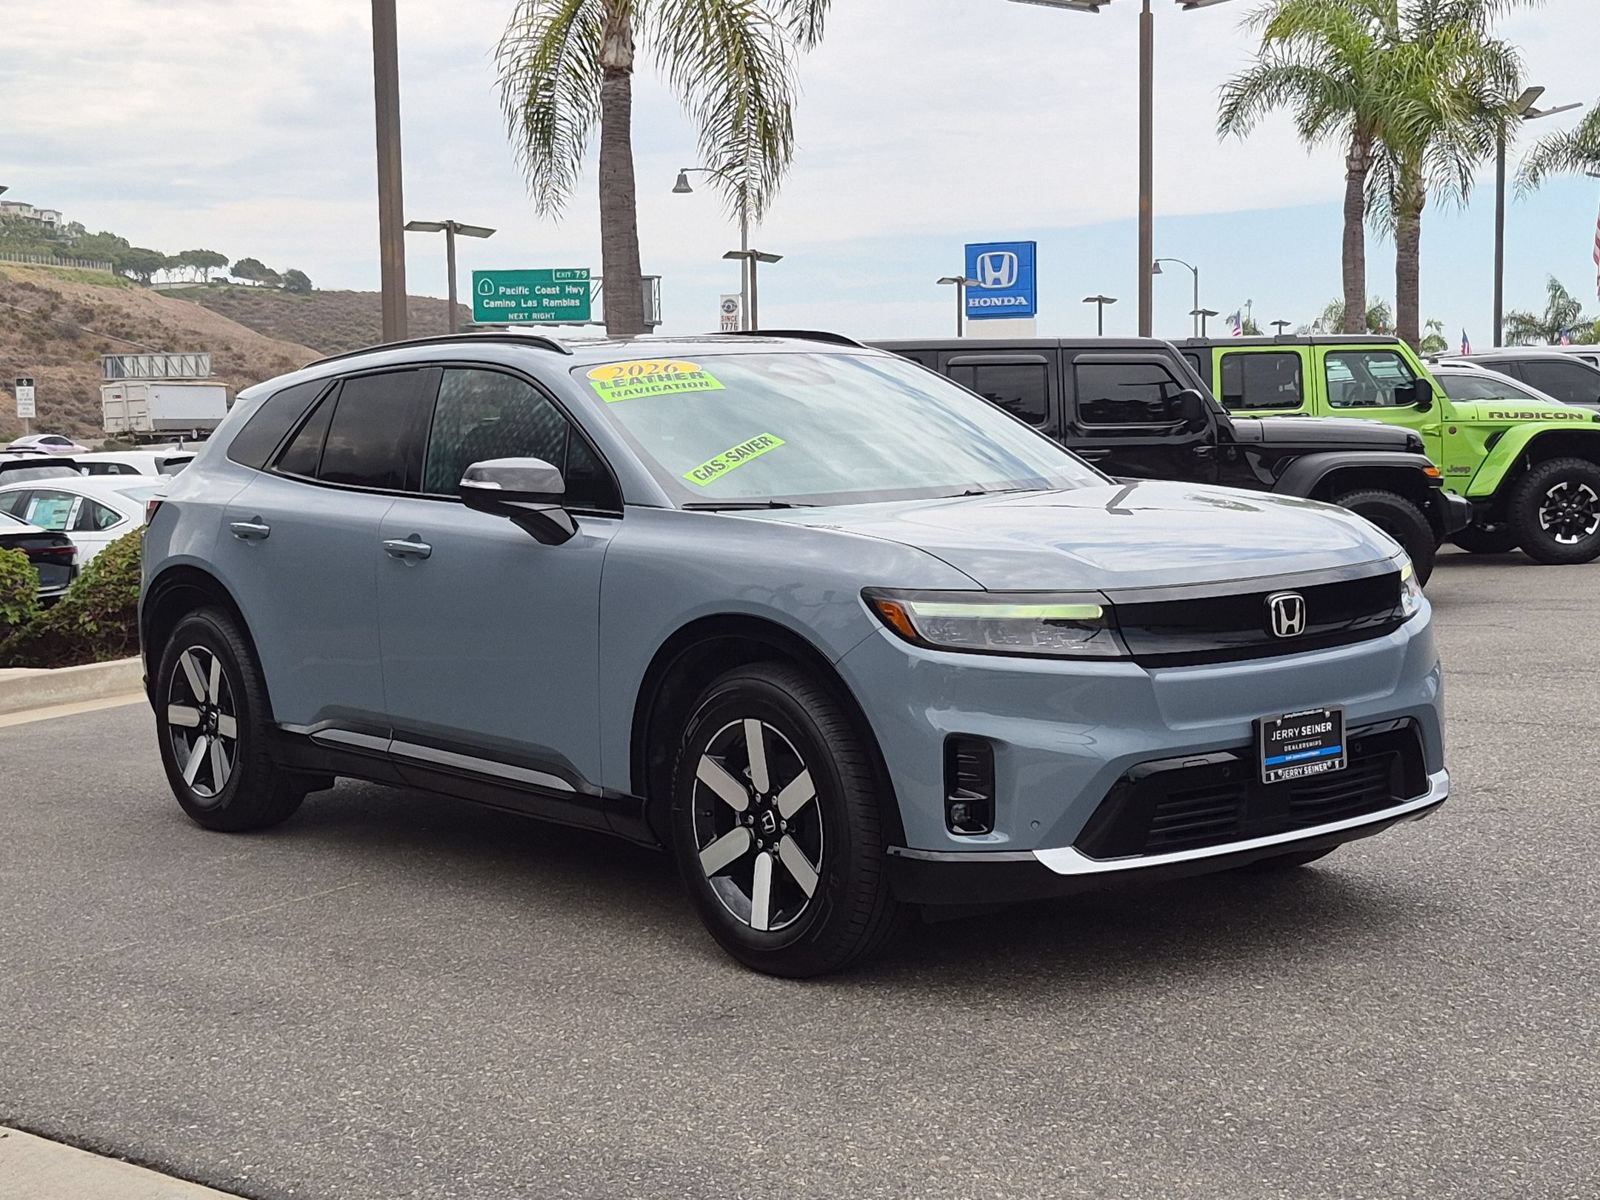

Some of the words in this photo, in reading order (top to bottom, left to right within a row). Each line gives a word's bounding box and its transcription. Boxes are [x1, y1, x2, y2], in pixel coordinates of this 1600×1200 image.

[574, 270, 588, 279] 79
[499, 286, 530, 295] Pacific
[535, 285, 560, 295] Coast
[565, 285, 585, 295] Hwy
[483, 299, 516, 308] Camino
[521, 299, 538, 307] Las
[543, 298, 580, 307] Ramblas
[968, 296, 1029, 307] HONDA
[532, 312, 556, 320] RIGHT
[609, 362, 679, 379] 2026
[600, 371, 705, 390] LEATHER
[611, 380, 710, 398] NAVIGATION
[1488, 411, 1584, 420] RUBICON
[1446, 464, 1471, 474] Jeep
[1271, 727, 1300, 741] JERRY
[1301, 722, 1332, 736] SEINER
[1284, 740, 1322, 752] DEALERSHIPS
[1282, 768, 1303, 779] JERRY
[1303, 763, 1328, 775] SEINER
